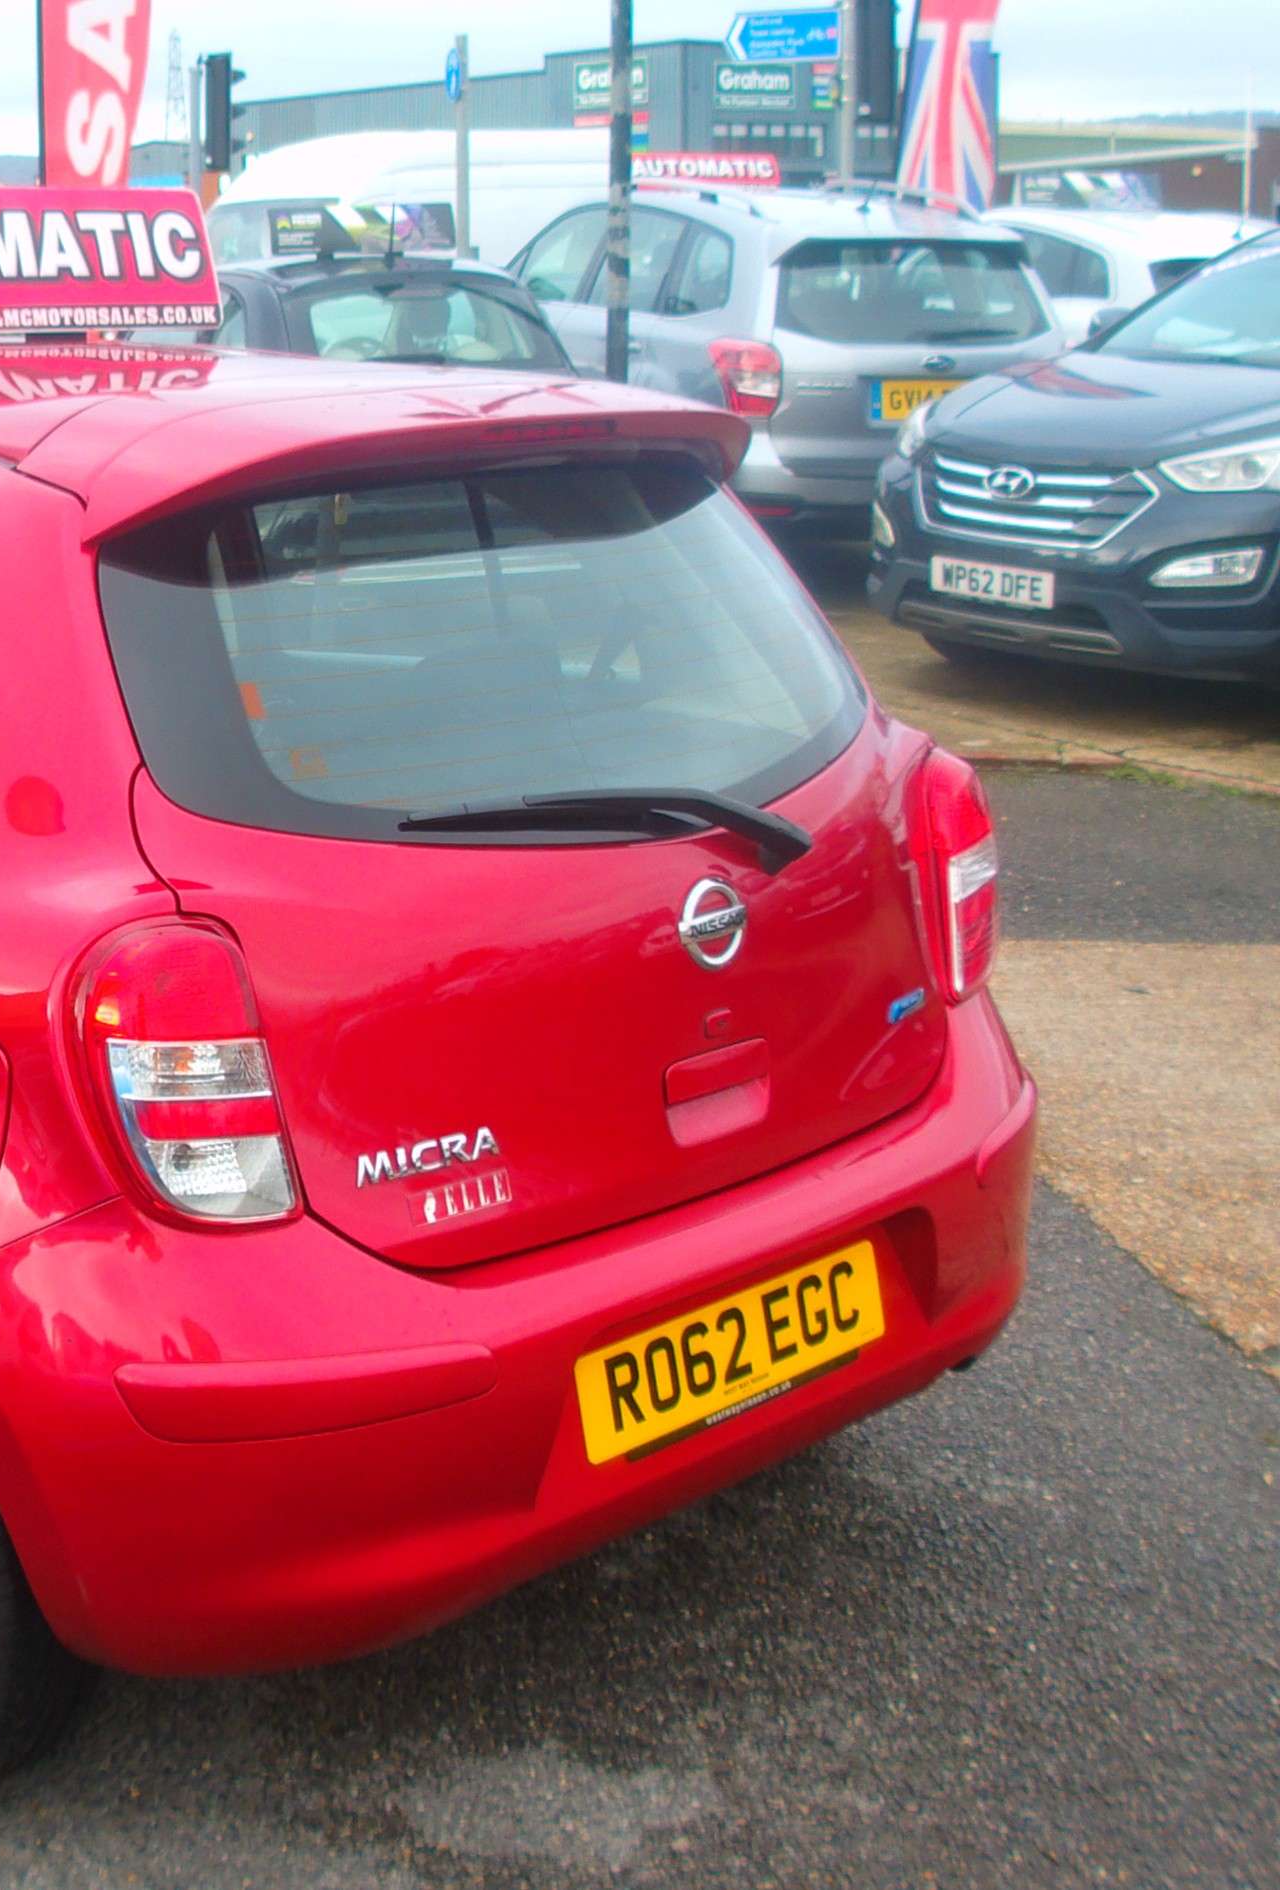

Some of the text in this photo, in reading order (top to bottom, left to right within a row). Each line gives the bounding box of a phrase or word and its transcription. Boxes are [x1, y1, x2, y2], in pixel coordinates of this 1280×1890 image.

[719, 67, 790, 90] Graham
[632, 157, 774, 178] AUTOMATIC
[941, 561, 1044, 601] WP62 DFE
[690, 909, 745, 938] NISSAN
[356, 1126, 500, 1188] MICRA
[443, 1172, 506, 1216] ELLE
[604, 1261, 860, 1433] RO62 EGC
